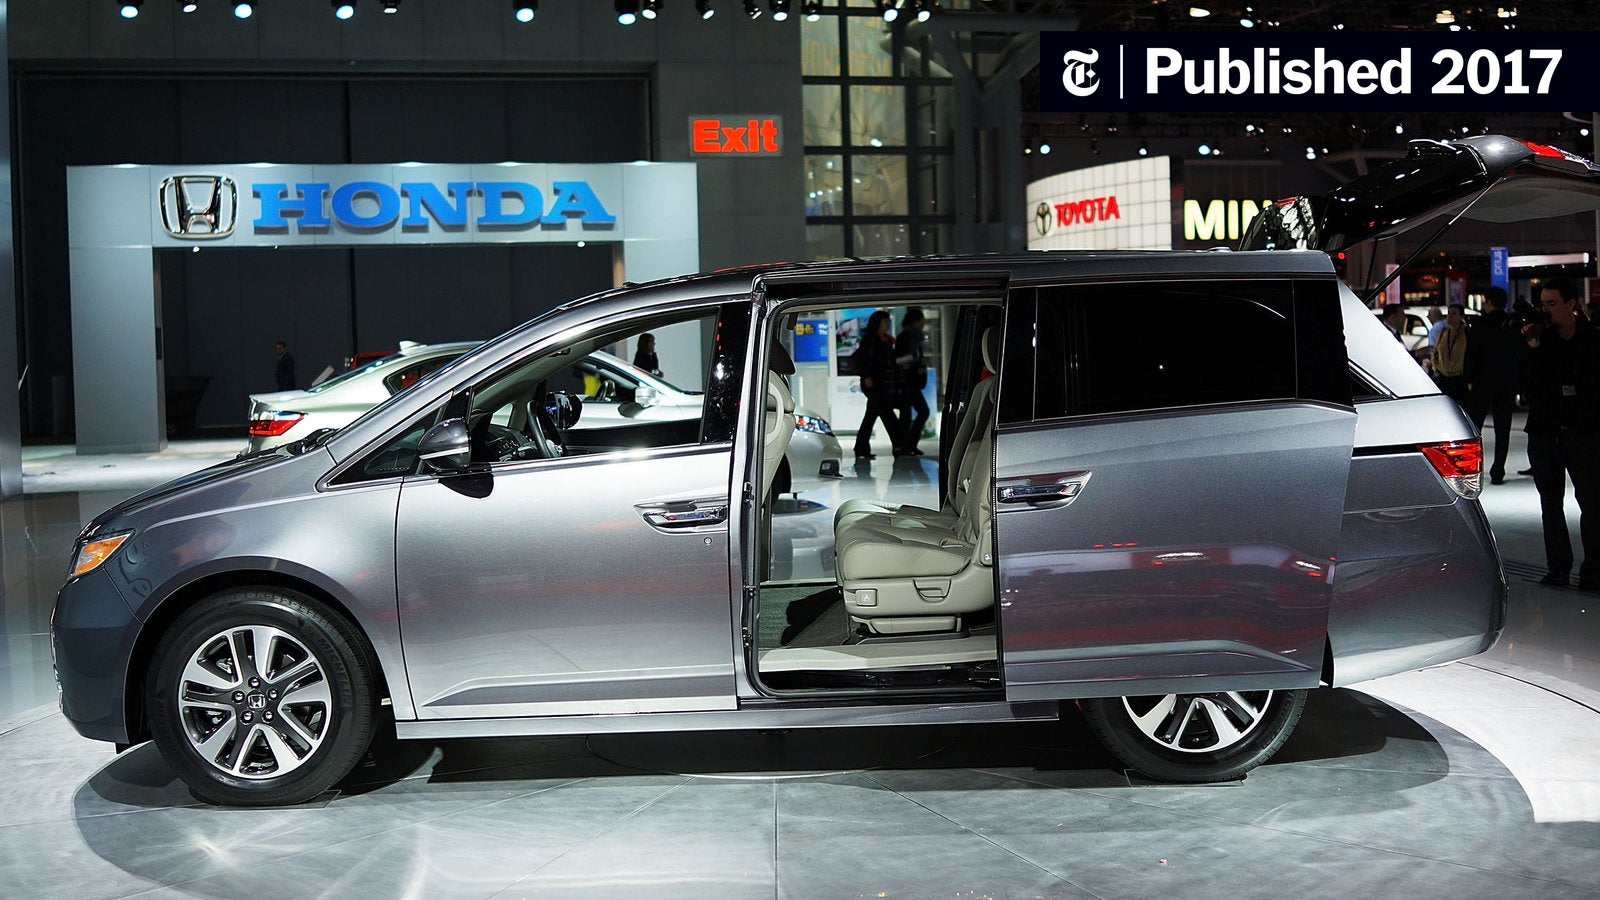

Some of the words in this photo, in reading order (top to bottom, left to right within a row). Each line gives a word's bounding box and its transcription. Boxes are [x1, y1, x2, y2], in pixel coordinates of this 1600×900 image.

[693, 119, 778, 152] Exit
[252, 181, 616, 231] HONDA
[1054, 195, 1120, 227] TOYOTA
